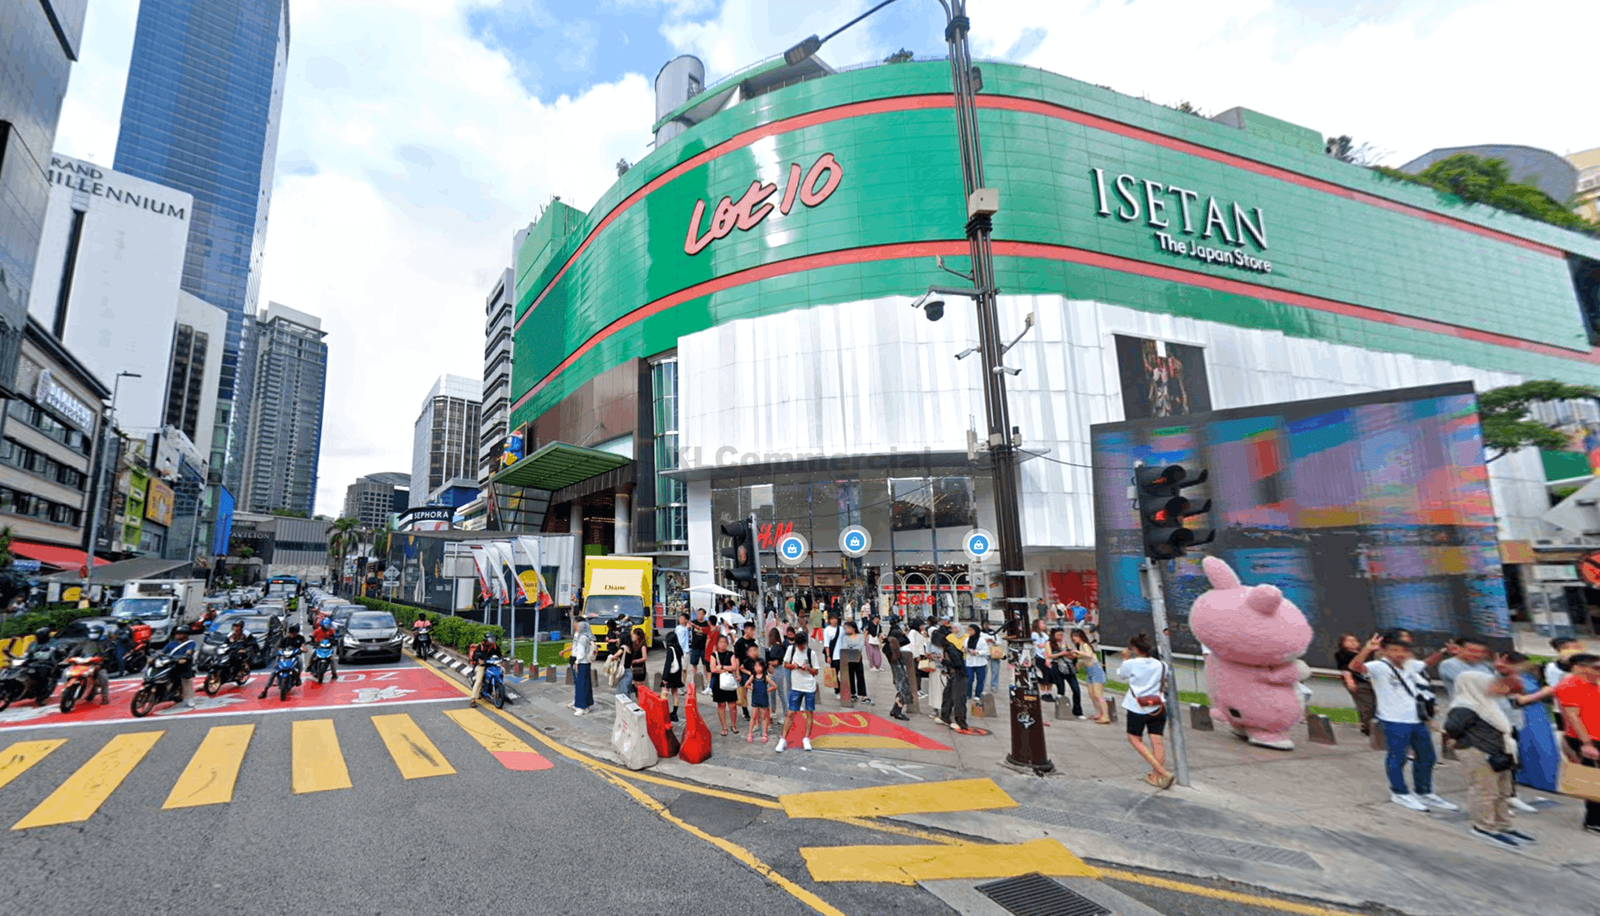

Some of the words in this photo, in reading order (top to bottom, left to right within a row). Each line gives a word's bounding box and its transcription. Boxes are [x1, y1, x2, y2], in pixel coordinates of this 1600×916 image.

[51, 156, 103, 180] RAND
[684, 180, 777, 256] Lot
[780, 153, 843, 215] 10
[1091, 167, 1268, 250] ISETAN
[1155, 231, 1187, 254] The
[1189, 240, 1233, 263] Japan
[1234, 249, 1272, 272] Store
[414, 511, 449, 520] SEPHORA
[231, 531, 270, 540] AVILION
[757, 521, 793, 550] H&M
[897, 591, 936, 605] Sale
